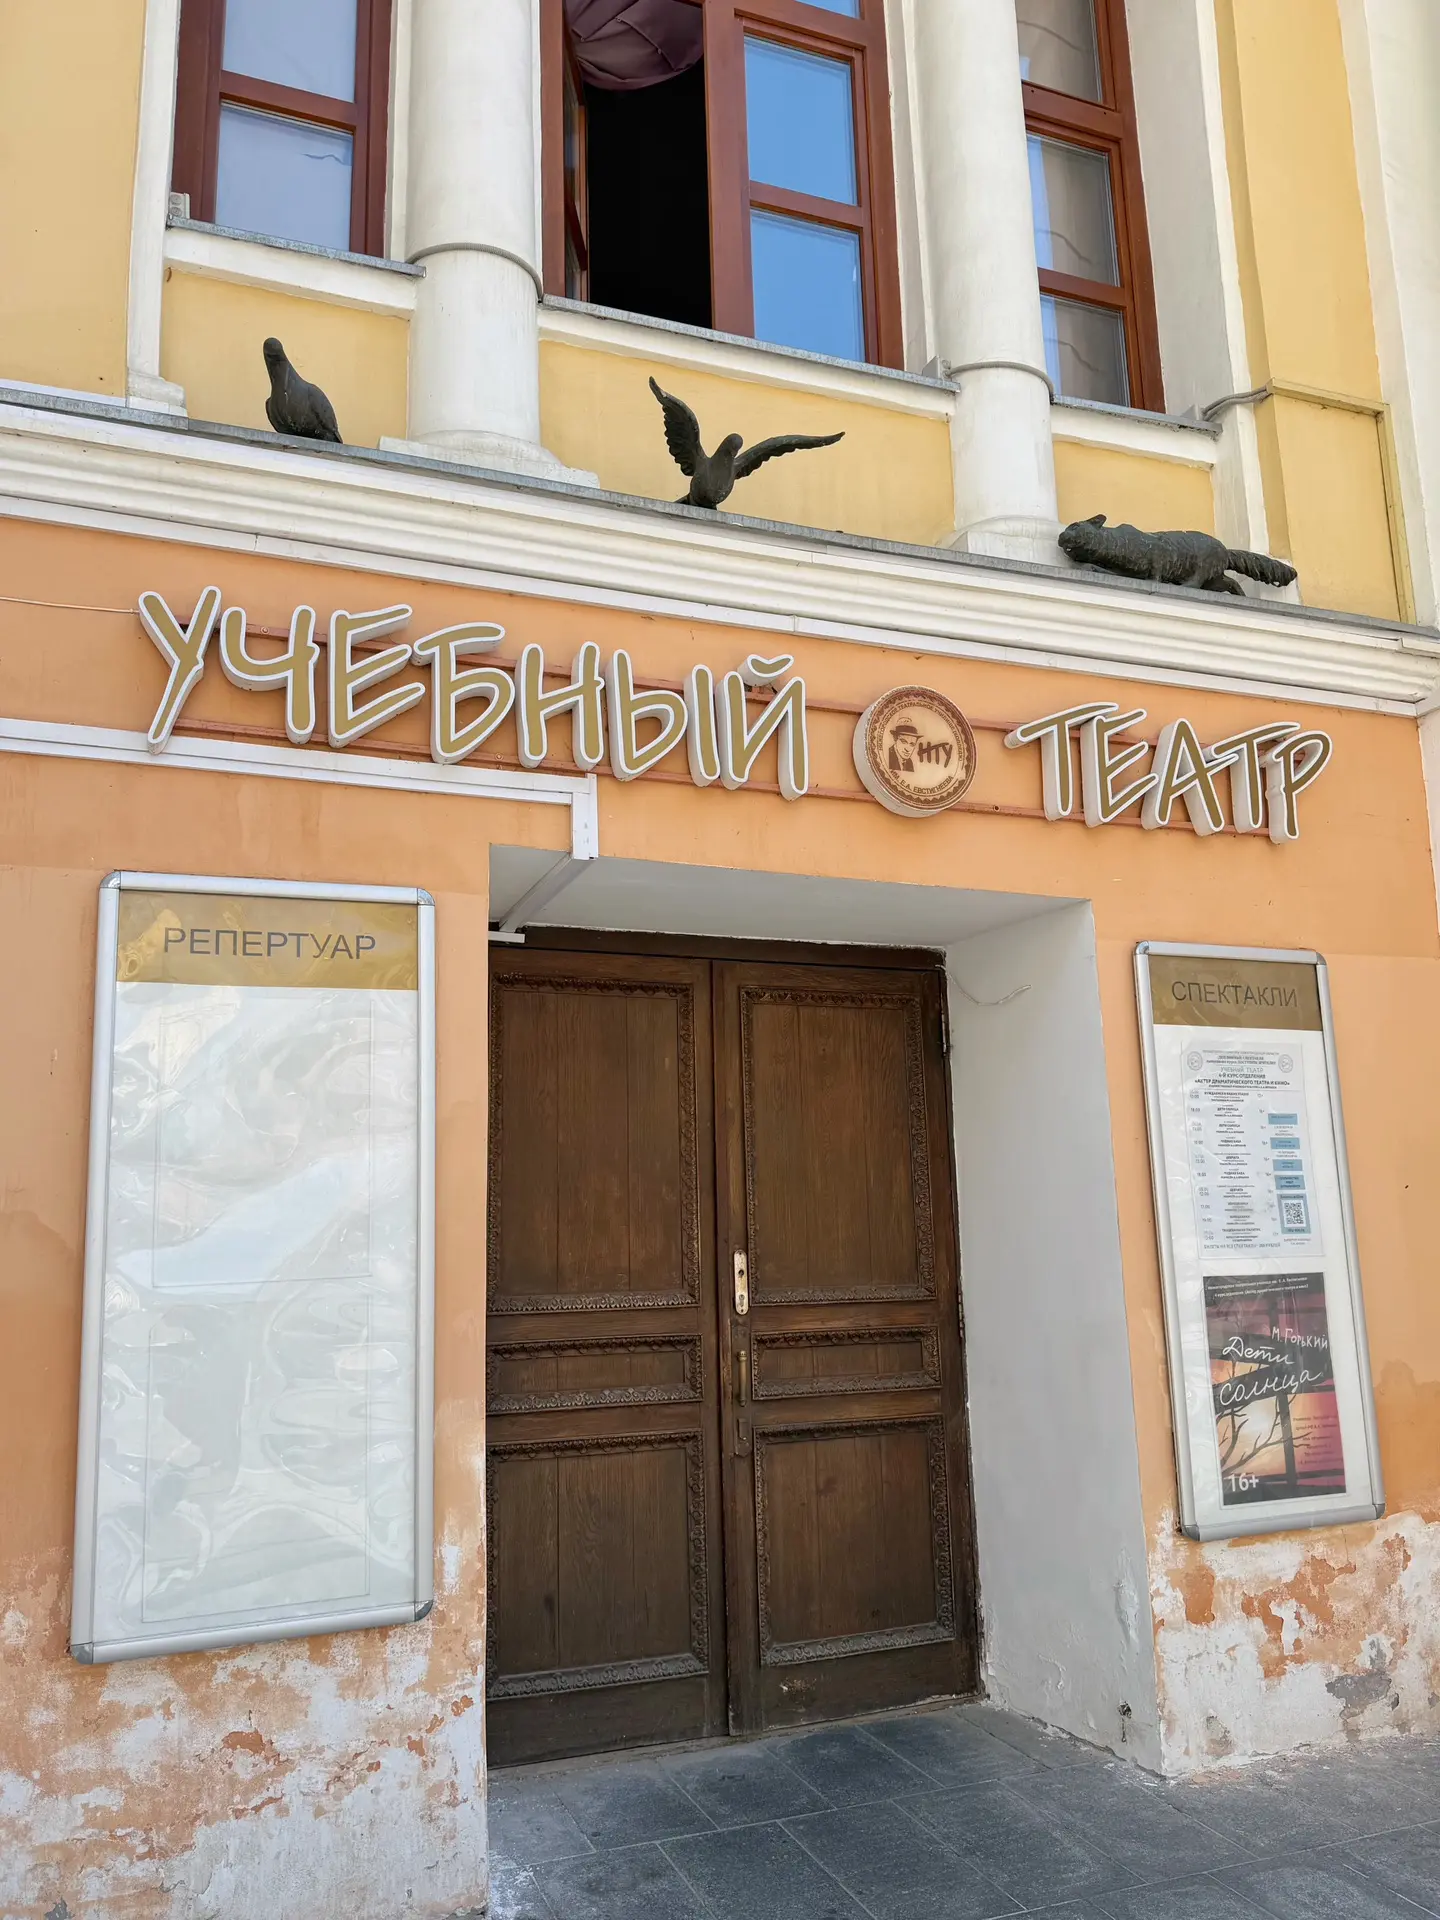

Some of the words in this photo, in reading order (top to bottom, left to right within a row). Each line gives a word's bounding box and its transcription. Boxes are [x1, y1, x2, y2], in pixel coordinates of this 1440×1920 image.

[138, 585, 809, 801] УЧЕБНЫЙ
[1004, 702, 1333, 843] ТЕАТР
[917, 741, 953, 768] НТУ
[912, 775, 955, 794] ЕВСТИГНЕЕВА
[163, 927, 377, 960] РЕПЕРТУАР
[1171, 981, 1298, 1007] СПЕКТАКЛИ
[1271, 1326, 1283, 1343] М.
[1222, 1336, 1295, 1365] Дети
[1228, 1472, 1260, 1492] 16+
